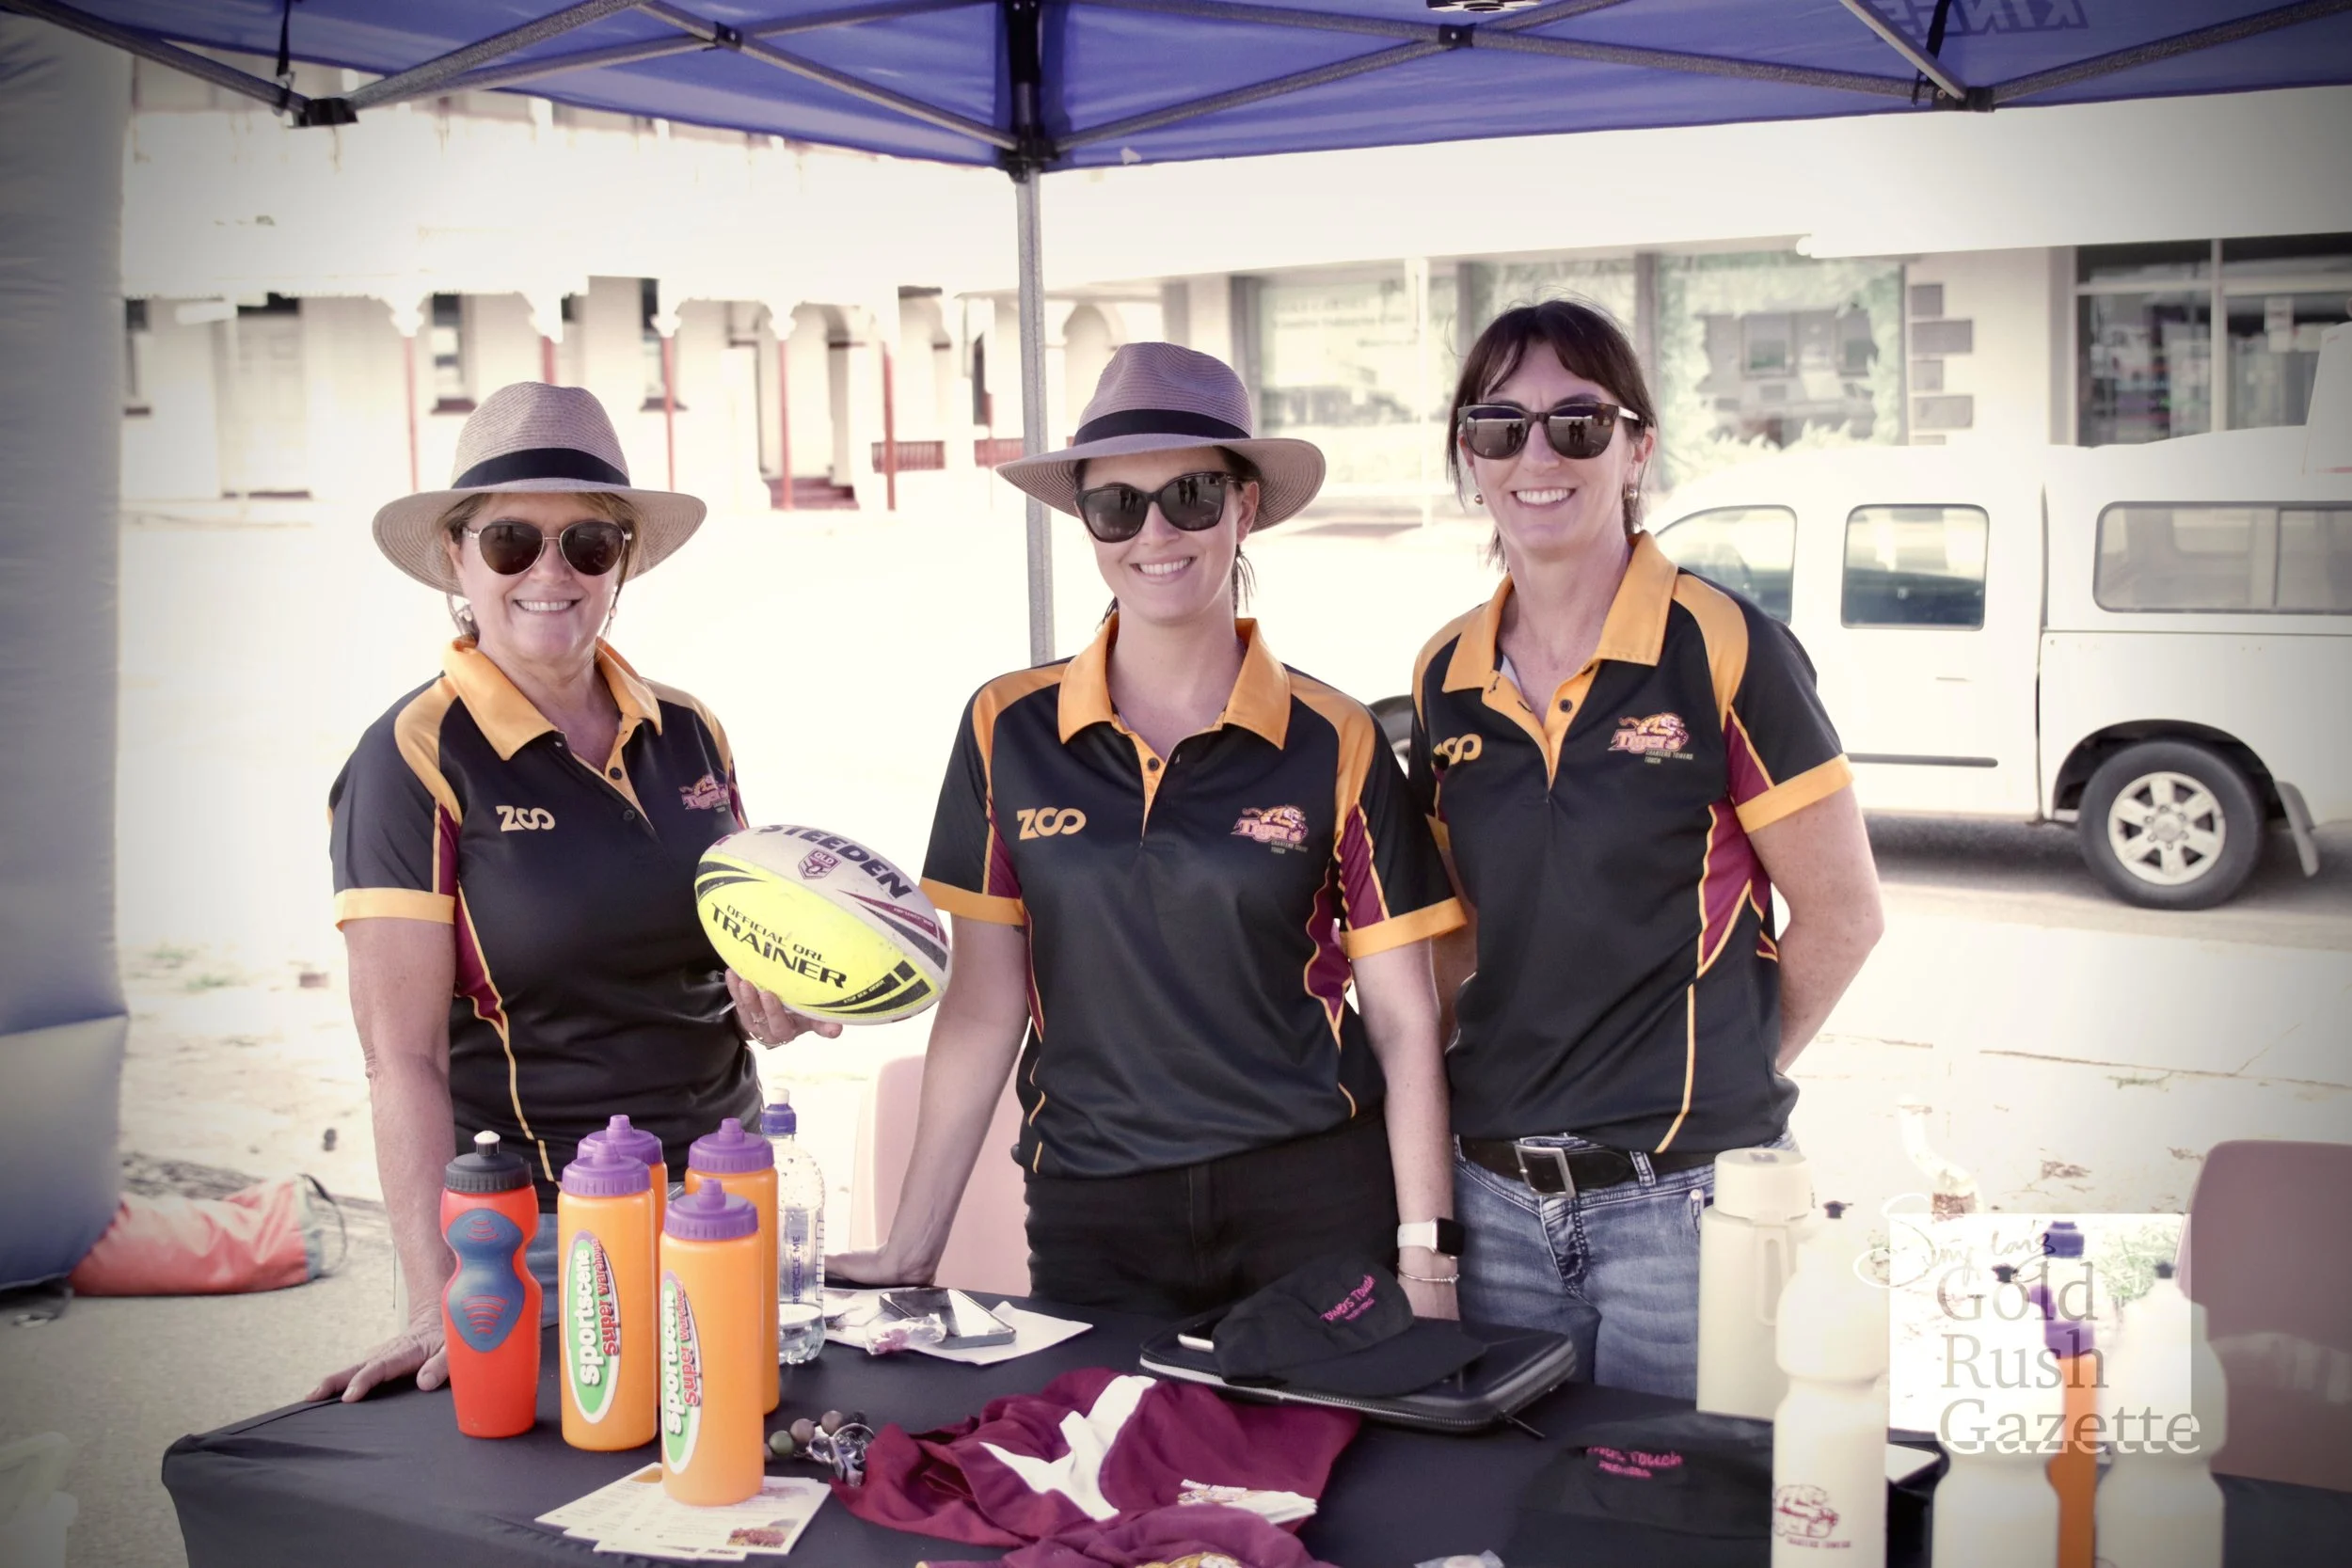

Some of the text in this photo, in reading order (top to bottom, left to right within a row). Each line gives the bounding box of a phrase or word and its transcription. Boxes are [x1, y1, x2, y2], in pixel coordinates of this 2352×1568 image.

[757, 825, 913, 899] STEEDEN
[710, 902, 848, 989] TRAINER
[726, 904, 787, 947] OFFICIAL
[792, 1235, 801, 1306] RECYCLE ME
[575, 1248, 607, 1386] sportscene
